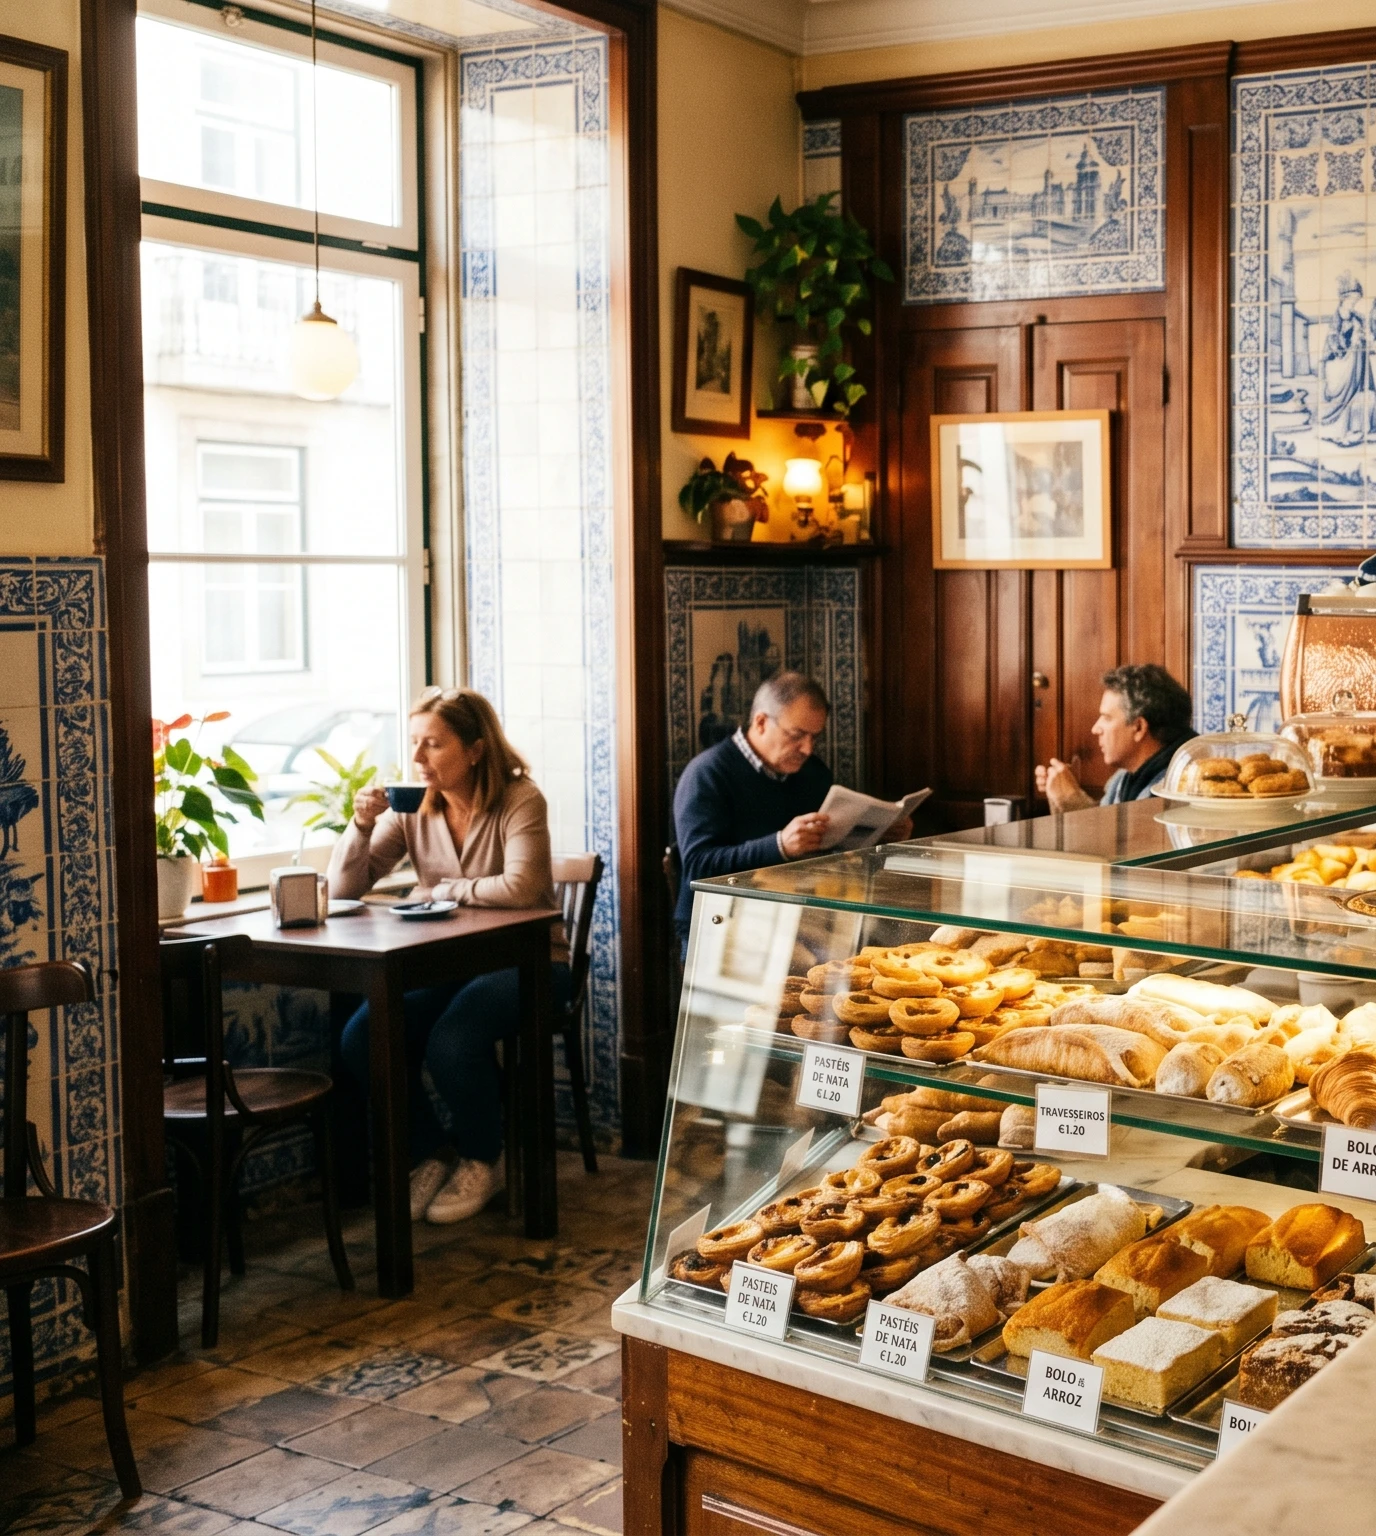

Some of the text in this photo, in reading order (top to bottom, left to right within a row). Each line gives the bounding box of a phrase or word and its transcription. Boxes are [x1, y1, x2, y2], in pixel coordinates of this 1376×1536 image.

[814, 1055, 850, 1073] PASTÉIS
[812, 1071, 849, 1088] DE NATA
[1040, 1106, 1105, 1122] TRAVESSEIROS
[1058, 1124, 1085, 1136] €1.20
[1332, 1157, 1349, 1171] DE
[742, 1275, 778, 1296] PASTEIS
[737, 1292, 776, 1312] DE NATA
[879, 1313, 919, 1335] PASTÉIS
[875, 1330, 917, 1352] DE NATA
[879, 1349, 907, 1367] €1.20
[1045, 1366, 1077, 1385] BOLO
[1042, 1386, 1083, 1408] ARROZ
